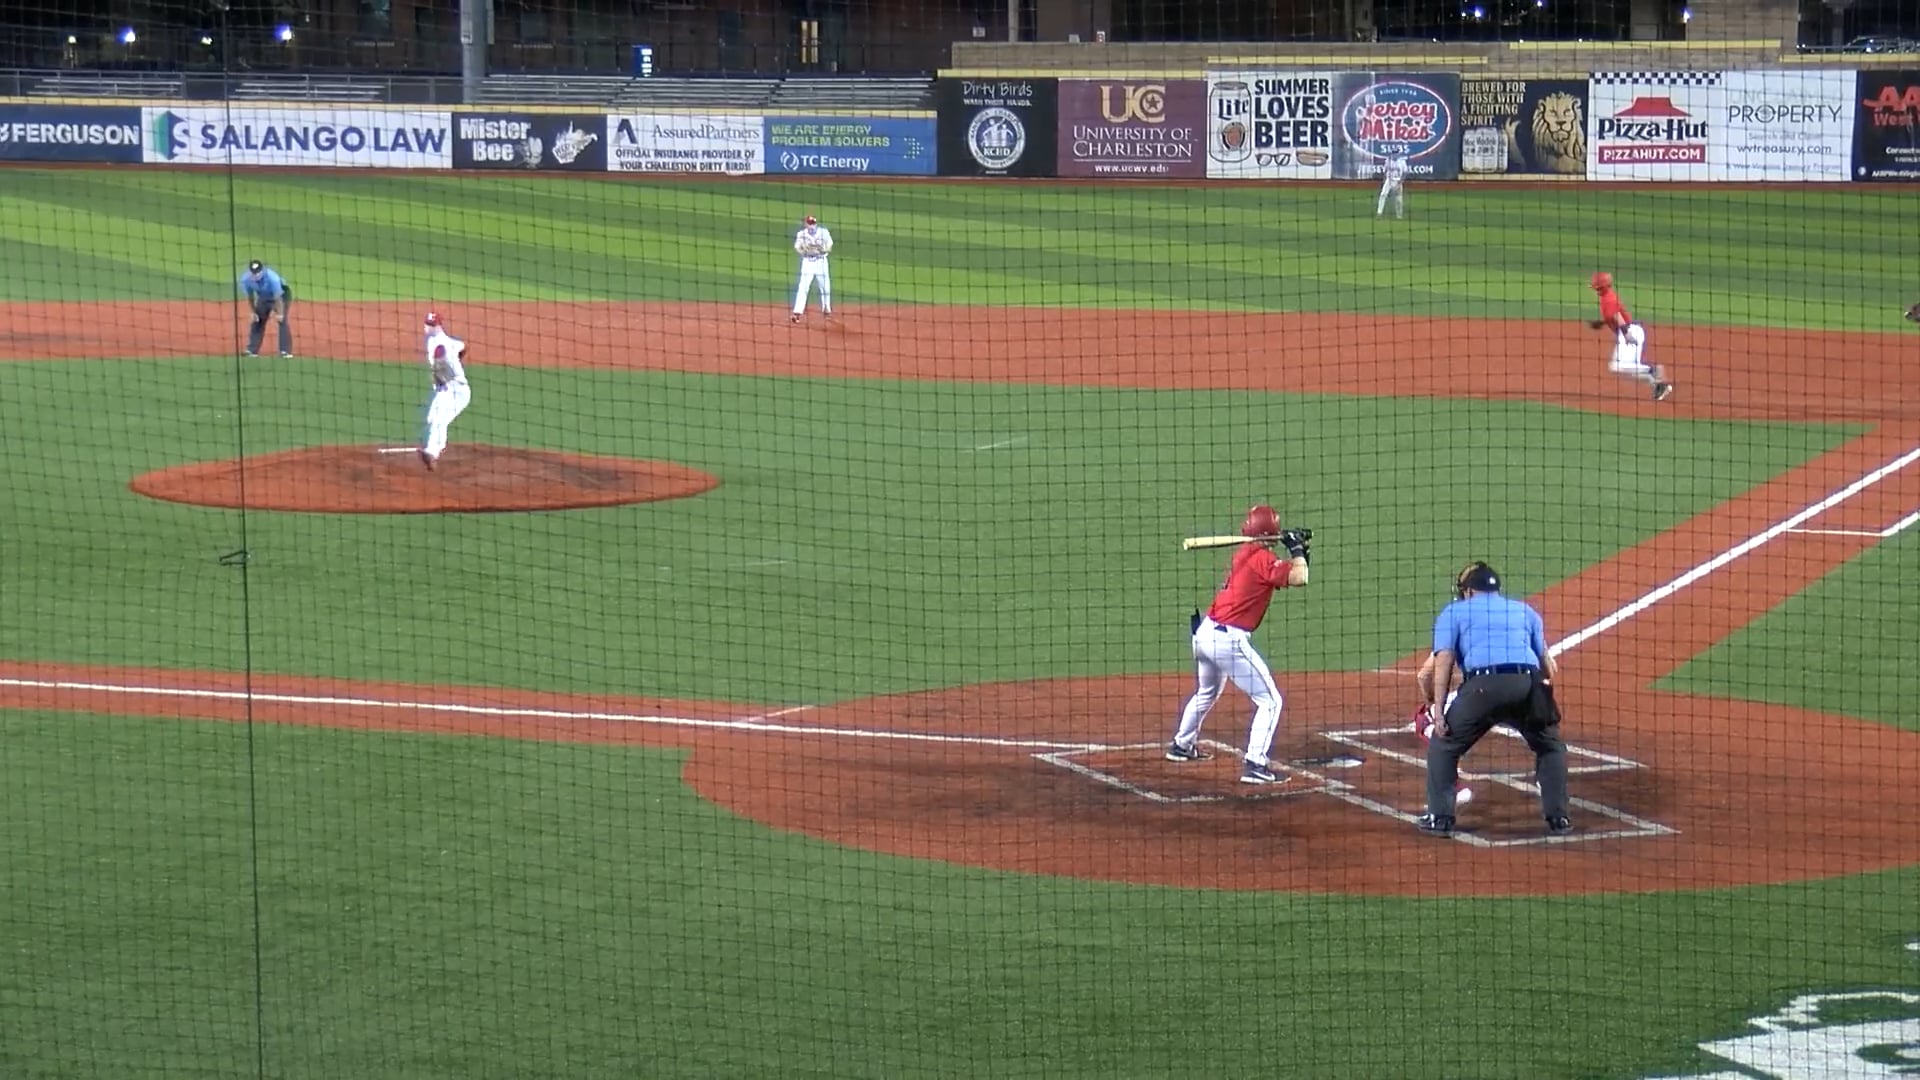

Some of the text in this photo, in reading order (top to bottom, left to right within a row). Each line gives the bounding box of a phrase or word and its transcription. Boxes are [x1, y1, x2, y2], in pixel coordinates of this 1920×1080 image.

[961, 81, 1033, 98] Dirty Birds
[1255, 78, 1329, 95] SUMMER
[1461, 82, 1526, 92] BREWED FOR
[1461, 93, 1524, 104] THOSE WITH
[1255, 96, 1329, 119] LOVES
[1356, 94, 1438, 125] Jersey
[1461, 104, 1518, 115] A FIGHTING
[1729, 104, 1842, 123] PROPERTY
[12, 123, 139, 145] FERGUSON
[459, 118, 531, 139] Mister
[771, 125, 872, 135] WE ARE ENERGY
[1073, 125, 1192, 140] UNIVERSITY OF
[1254, 120, 1329, 148] BEER
[1598, 118, 1708, 140] Pizza Hut
[200, 124, 447, 153] SALANGO LAW
[771, 135, 890, 147] PROBLEM SOLVERS
[473, 141, 515, 161] Bee
[615, 149, 756, 159] OFFICIAL INSURANCE PROVIDER OF
[1073, 140, 1192, 157] CHARLESTON
[1603, 148, 1701, 161] PIZZAHUT.COM
[1736, 144, 1832, 156] wvtreasury.com
[619, 161, 643, 170] YOUR
[645, 161, 698, 171] CHARLESTON
[700, 162, 722, 171] DIRTY
[800, 155, 870, 171] TC Energy
[1094, 164, 1169, 173] www.ucwv.edu
